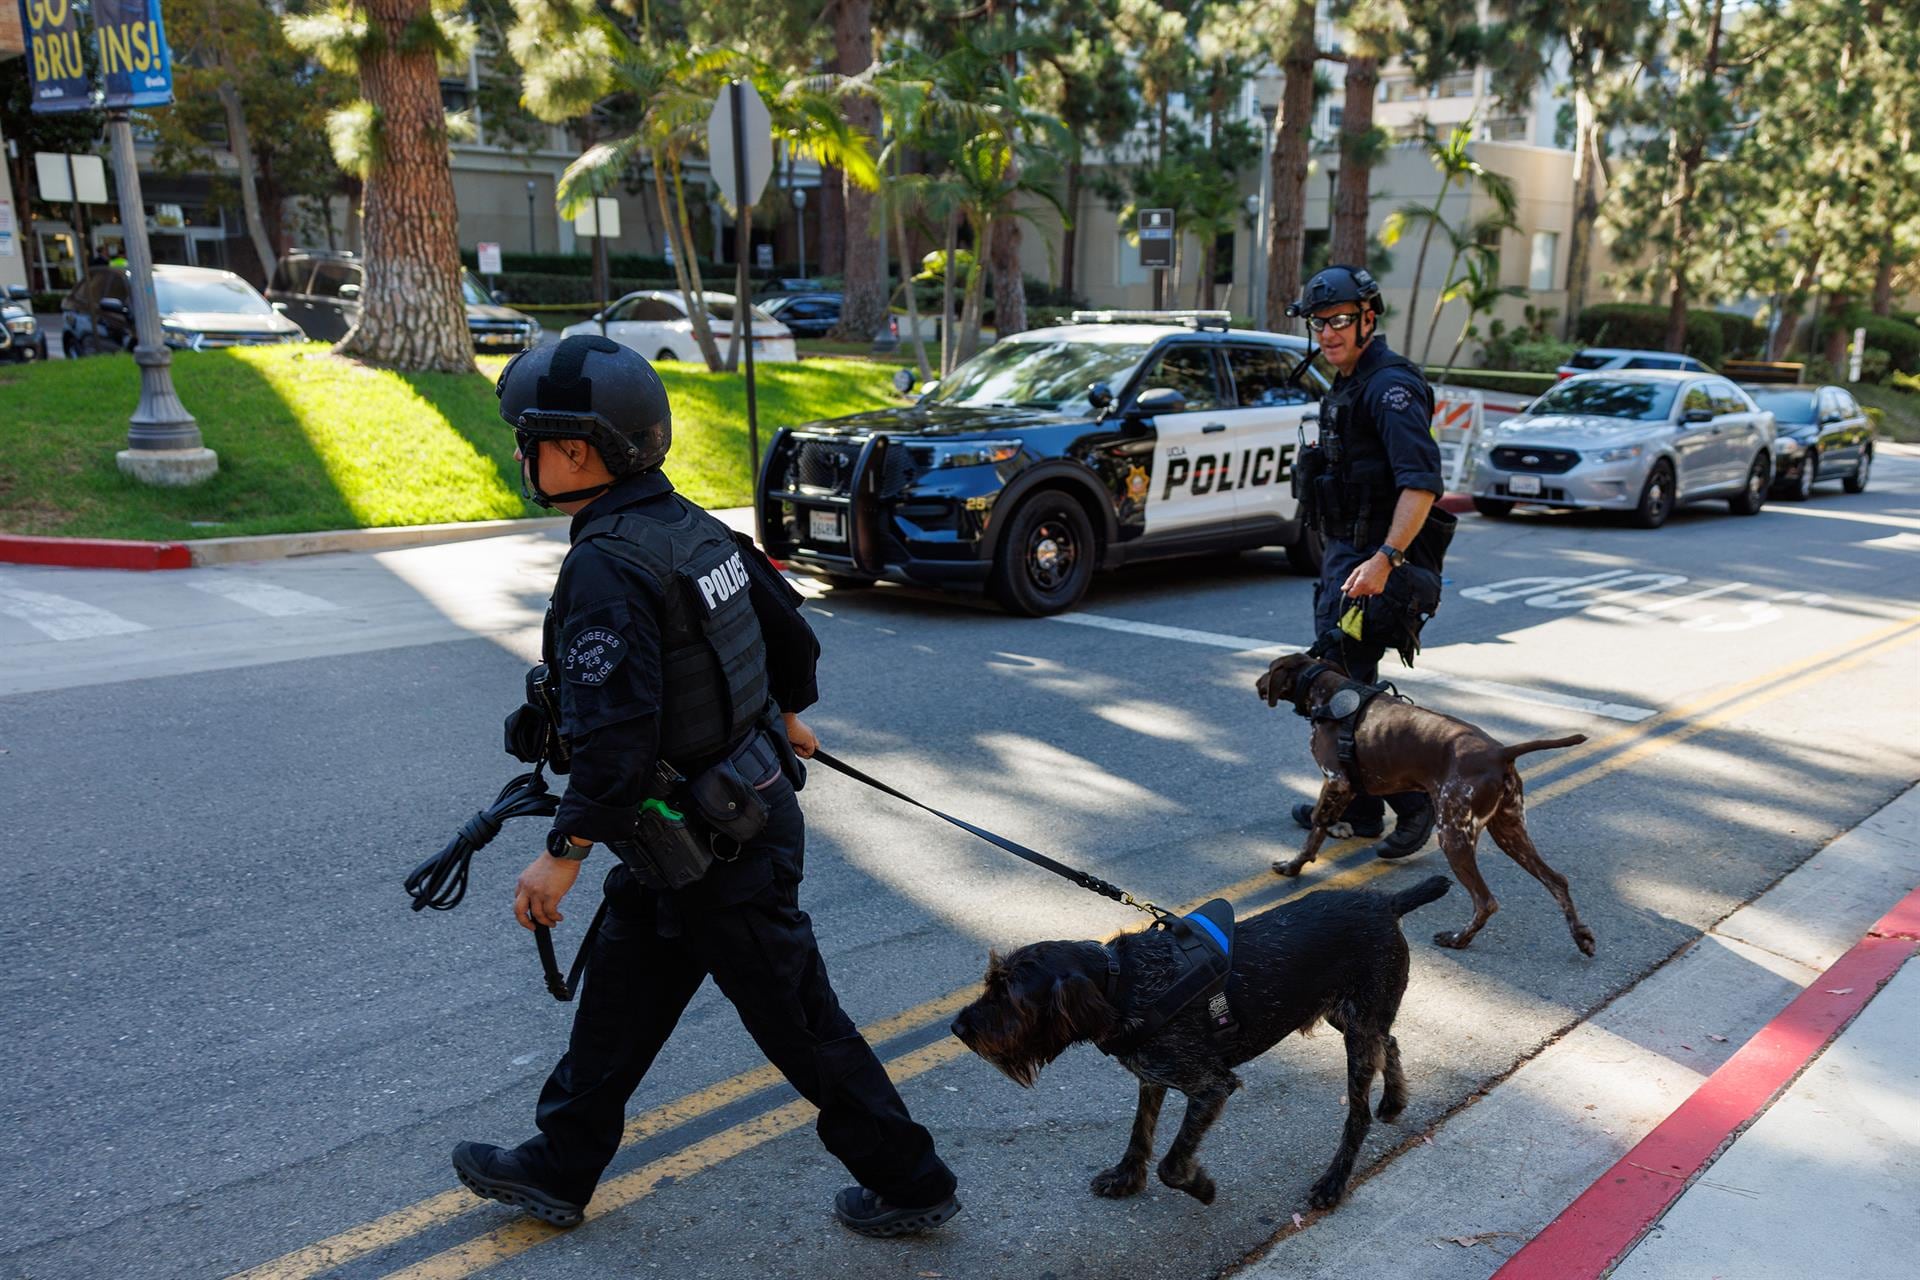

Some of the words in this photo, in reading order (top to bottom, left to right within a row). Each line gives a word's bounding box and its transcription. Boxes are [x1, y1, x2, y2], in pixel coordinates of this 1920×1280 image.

[26, 0, 67, 29] GO
[32, 30, 83, 82] BRU
[98, 20, 161, 74] INS!
[1162, 444, 1295, 500] POLICE
[966, 497, 986, 510] 25
[566, 647, 577, 670] LOS
[576, 631, 620, 648] ANGELES
[577, 645, 605, 664] BOMB
[586, 656, 601, 669] K-9
[582, 661, 613, 682] POLICE
